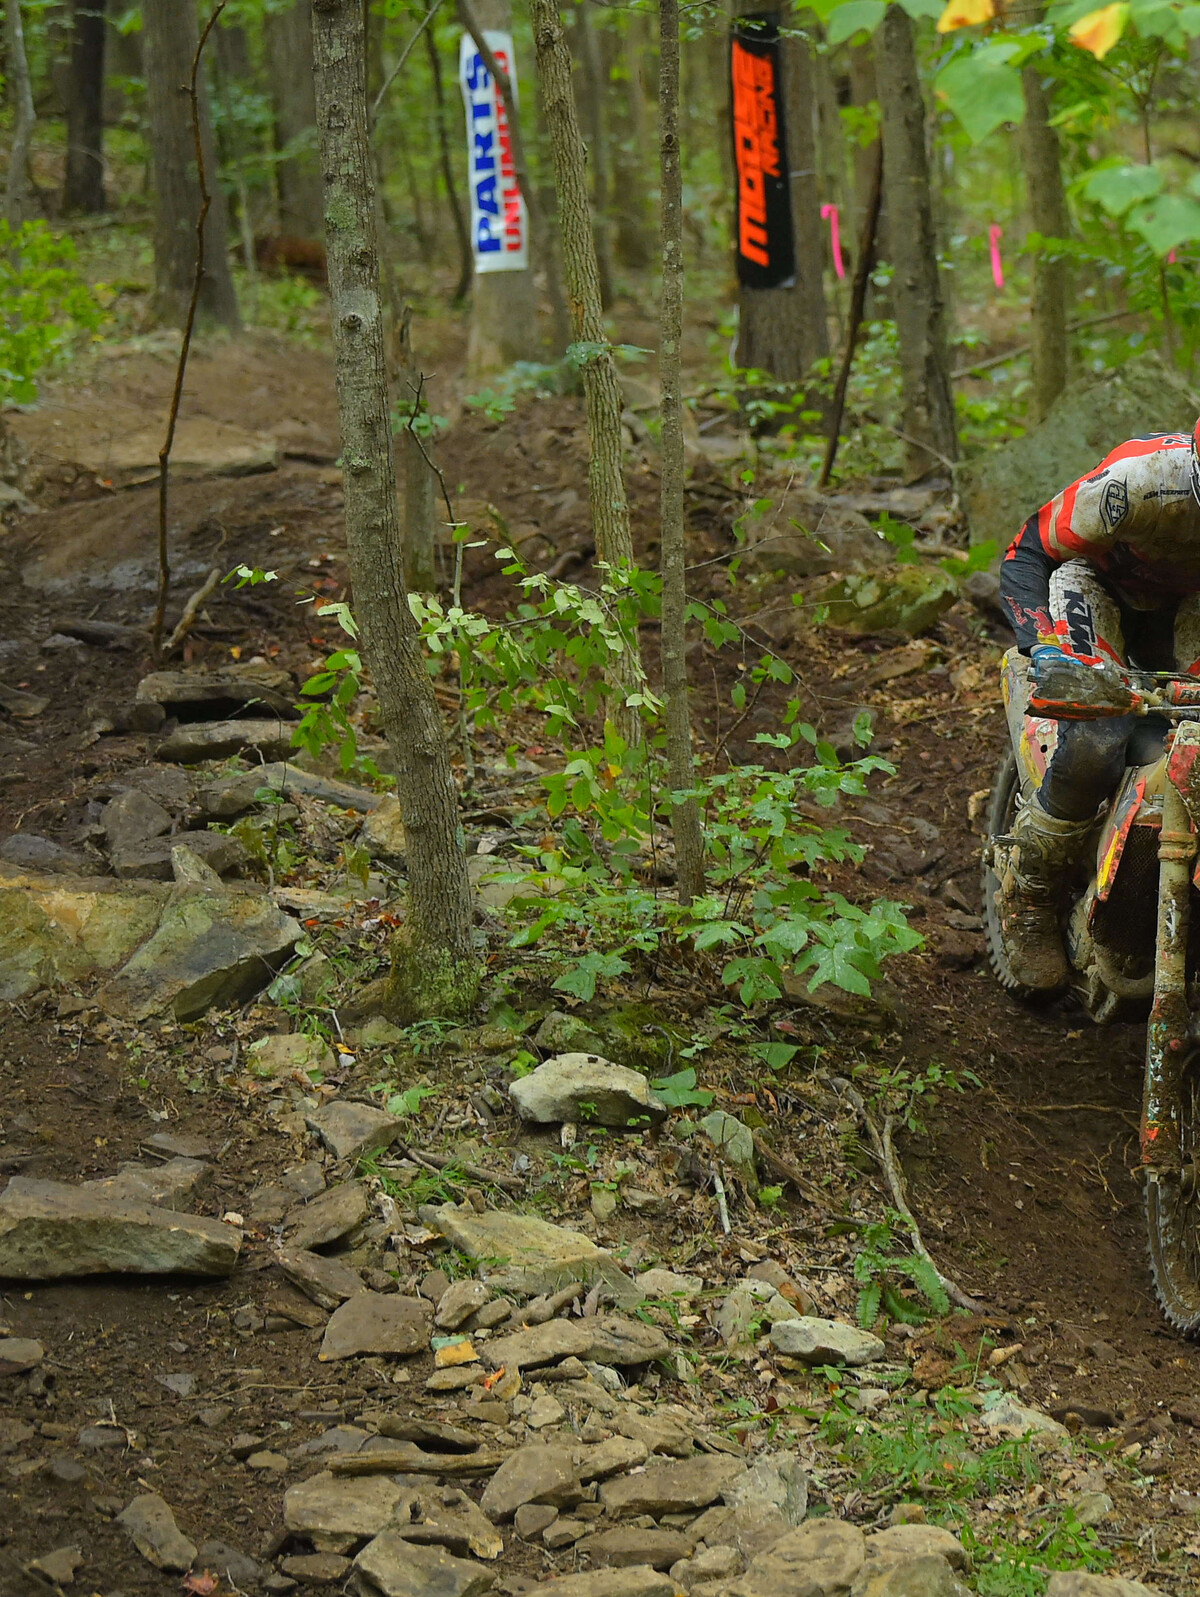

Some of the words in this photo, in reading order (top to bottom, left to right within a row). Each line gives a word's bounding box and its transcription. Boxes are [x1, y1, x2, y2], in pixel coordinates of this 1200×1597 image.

[466, 51, 501, 253] PARTS
[732, 40, 769, 267] MOOSE
[754, 55, 782, 178] RACING
[1064, 590, 1097, 657] KTM
